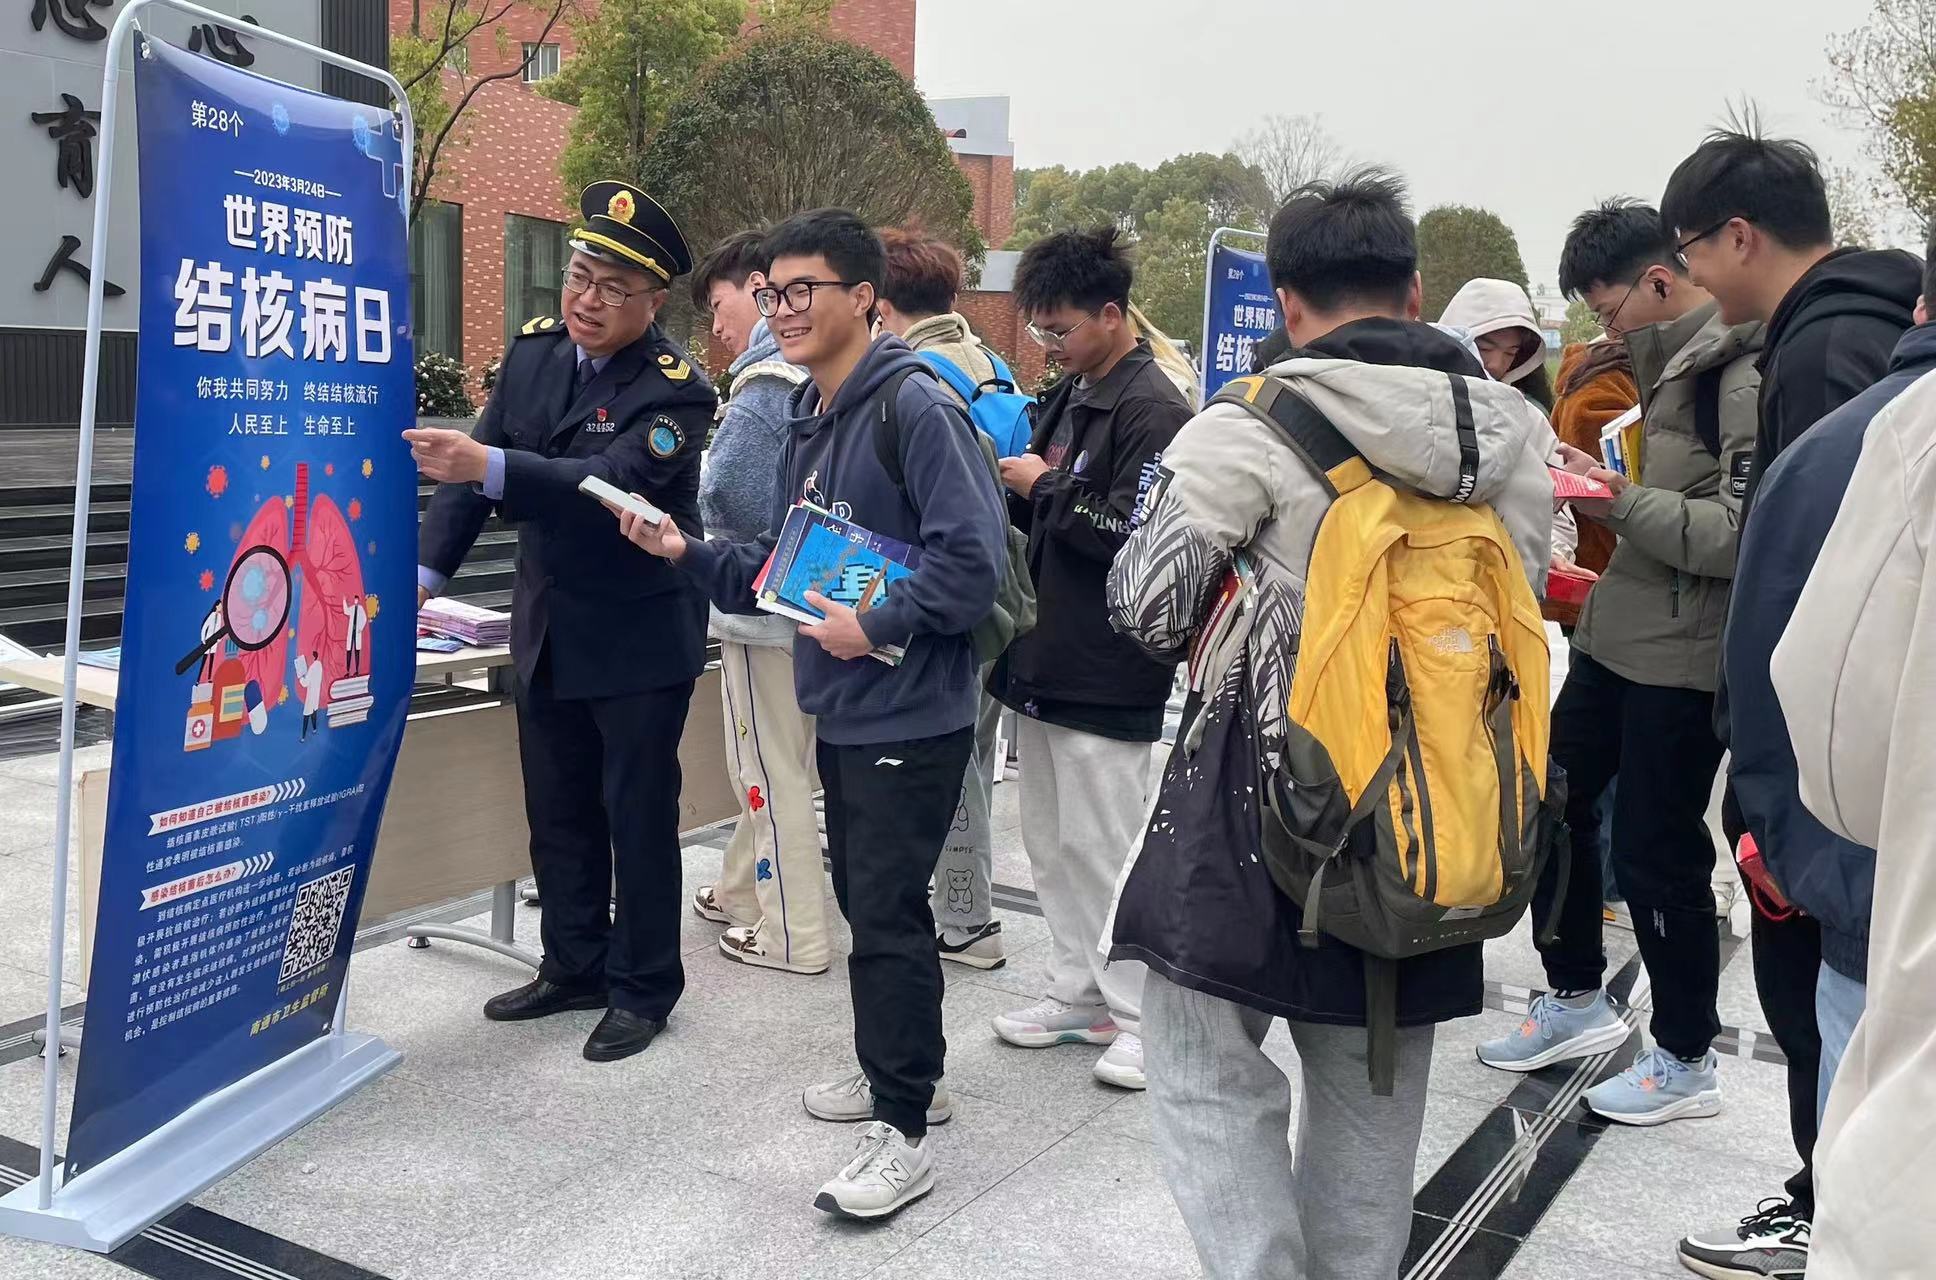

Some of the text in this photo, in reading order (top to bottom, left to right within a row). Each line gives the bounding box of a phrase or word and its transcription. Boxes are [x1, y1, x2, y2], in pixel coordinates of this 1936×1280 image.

[191, 101, 244, 137] 第28个
[224, 194, 353, 266] 世界预防
[174, 258, 392, 365] 结核病日
[1234, 304, 1276, 331] 世界预防
[197, 376, 379, 405] 你我共同努力 终结结核流行
[228, 412, 356, 437] 人民至上 生命至上
